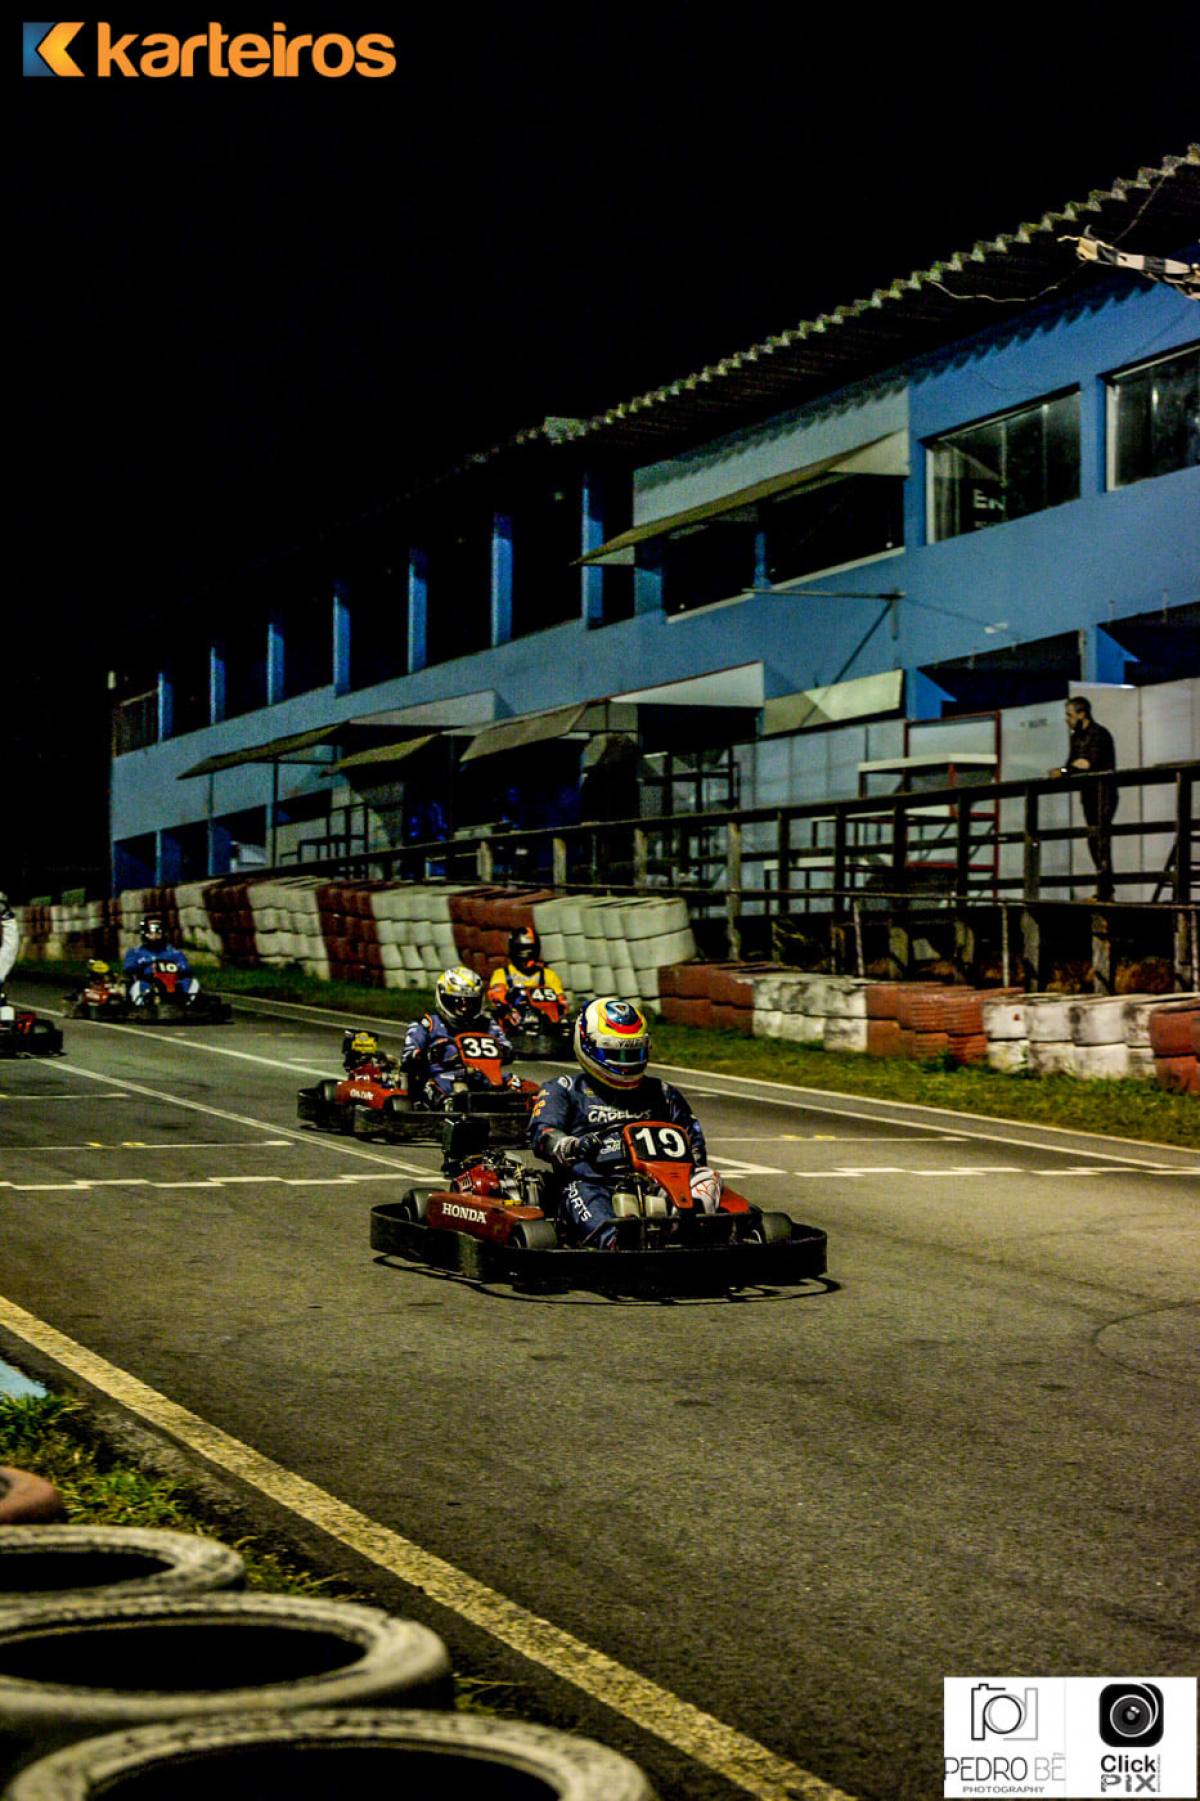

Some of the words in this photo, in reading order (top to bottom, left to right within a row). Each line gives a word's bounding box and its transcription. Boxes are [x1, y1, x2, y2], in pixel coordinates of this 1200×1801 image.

[159, 962, 178, 972] 10
[532, 988, 557, 1001] 45
[463, 1037, 498, 1058] 35
[635, 1128, 686, 1158] 19
[442, 1202, 487, 1224] HONDA
